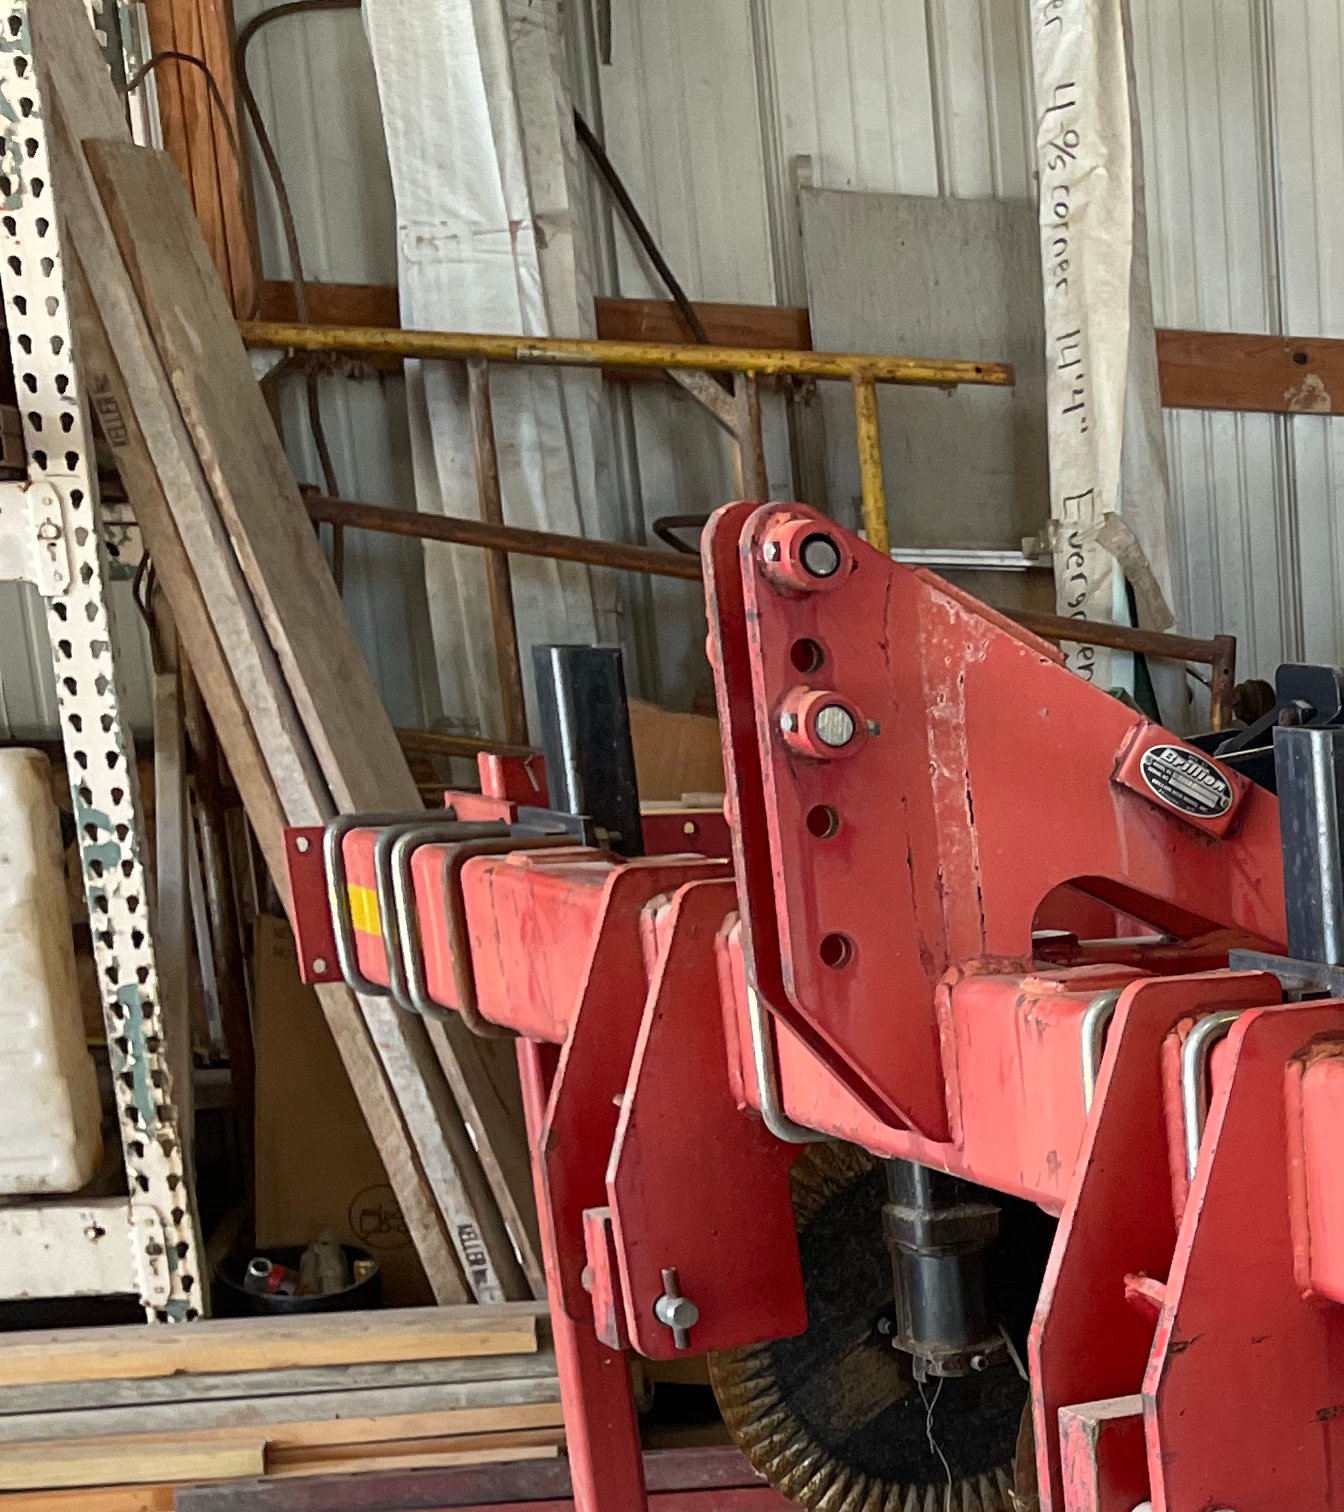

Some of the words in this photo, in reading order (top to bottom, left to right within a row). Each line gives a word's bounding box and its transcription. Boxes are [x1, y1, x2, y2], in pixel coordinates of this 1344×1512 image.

[1045, 82, 1076, 113] 4
[1050, 184, 1070, 296] corner
[1062, 488, 1095, 681] Evergren
[1160, 748, 1226, 792] Brillion
